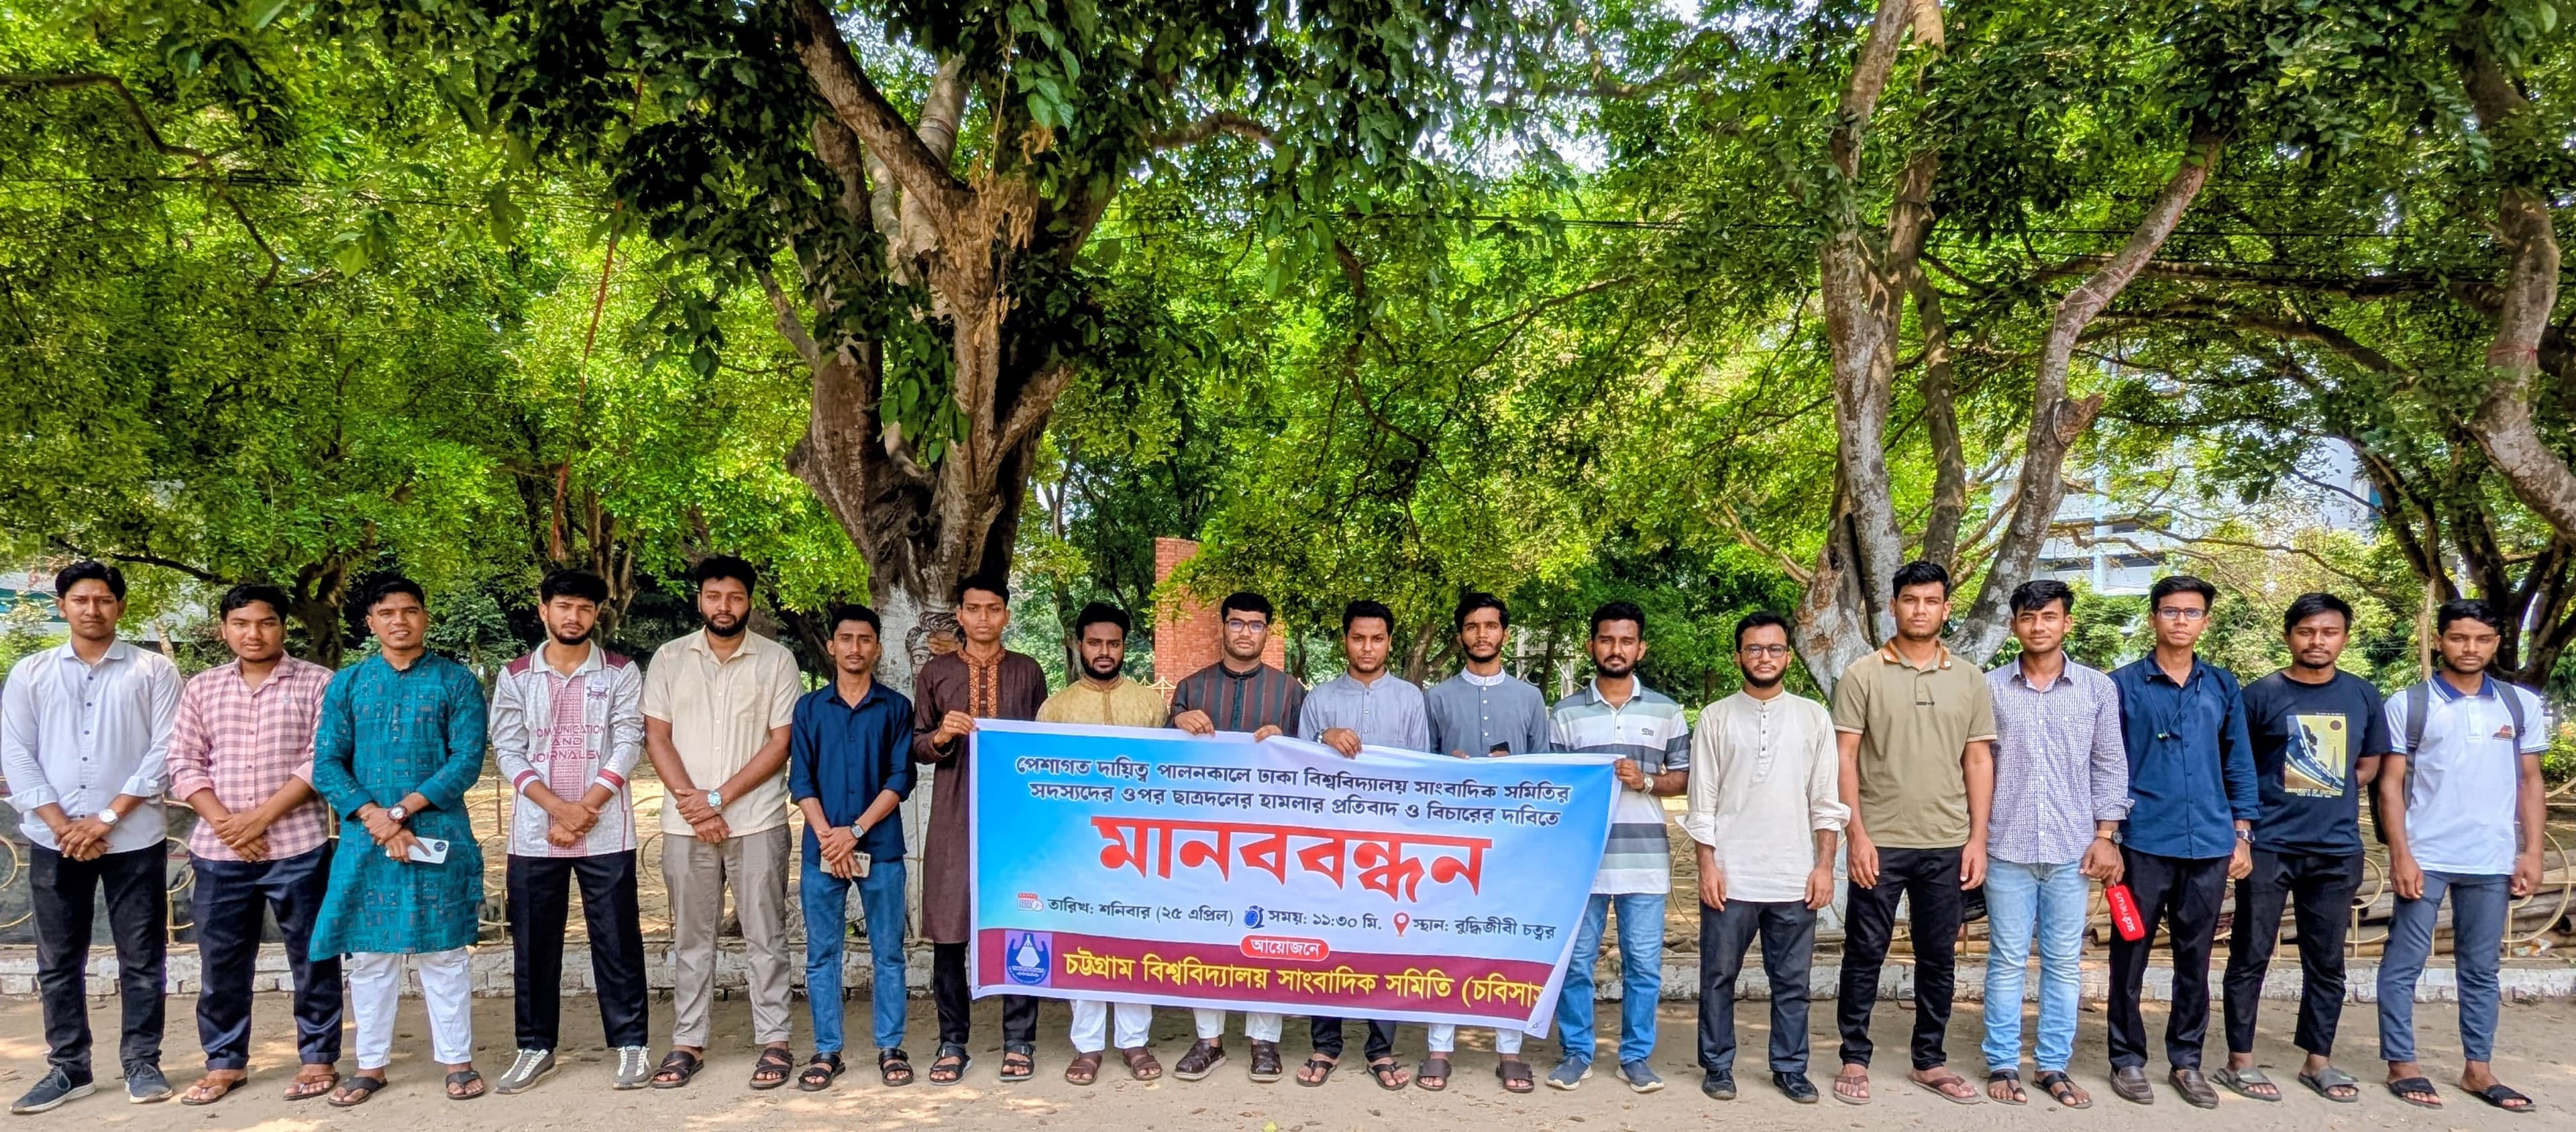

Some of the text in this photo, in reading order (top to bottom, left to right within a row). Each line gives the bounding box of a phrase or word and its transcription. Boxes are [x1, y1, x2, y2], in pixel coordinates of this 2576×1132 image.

[551, 737, 582, 745] AND
[1016, 756, 1571, 803] পেশাগত দায়িত্ব পালনকালে ঢাকা বিশ্ববিদ্যালয় সাংবাদিক সমিতির
[1029, 783, 1561, 826] সদস্যদের ওপর ছাত্রদলের হামলার প্রতিবাদ ও বিচারের দাবিতে
[1090, 816, 1493, 903] মানববন্ধন
[1047, 896, 1556, 941] তারিখ: শনিবার (২৫ এপ্রিল) সময়: ১১:৩০ মি. স্থান: বুদ্ধিজীবী চত্বর
[1250, 939, 1321, 957] আয়োজনে
[1063, 947, 1136, 981] চট্টগ্রাম
[1142, 953, 1271, 990] বিশ্ববিদ্যালয়
[1276, 966, 1379, 996] সাংবাদিক
[1384, 968, 1455, 998] সমিতি
